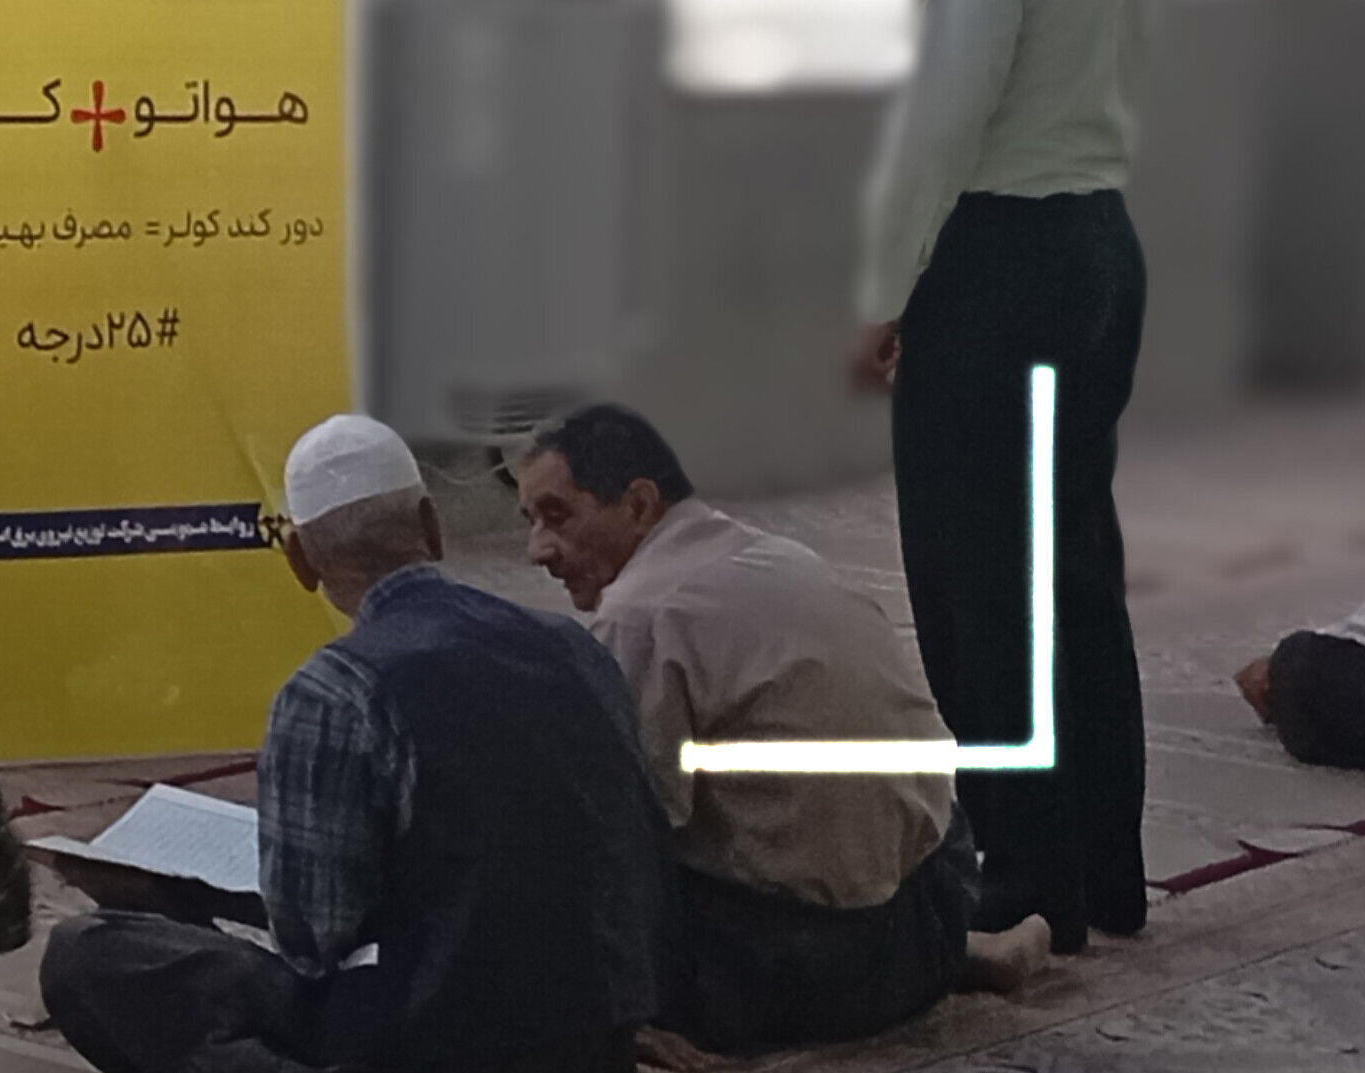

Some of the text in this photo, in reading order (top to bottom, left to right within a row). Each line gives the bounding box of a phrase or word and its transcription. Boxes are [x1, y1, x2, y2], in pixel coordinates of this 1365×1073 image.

[133, 79, 310, 138] هواتو
[51, 209, 133, 247] مصرف
[227, 208, 273, 240] کند
[278, 213, 325, 246] دور
